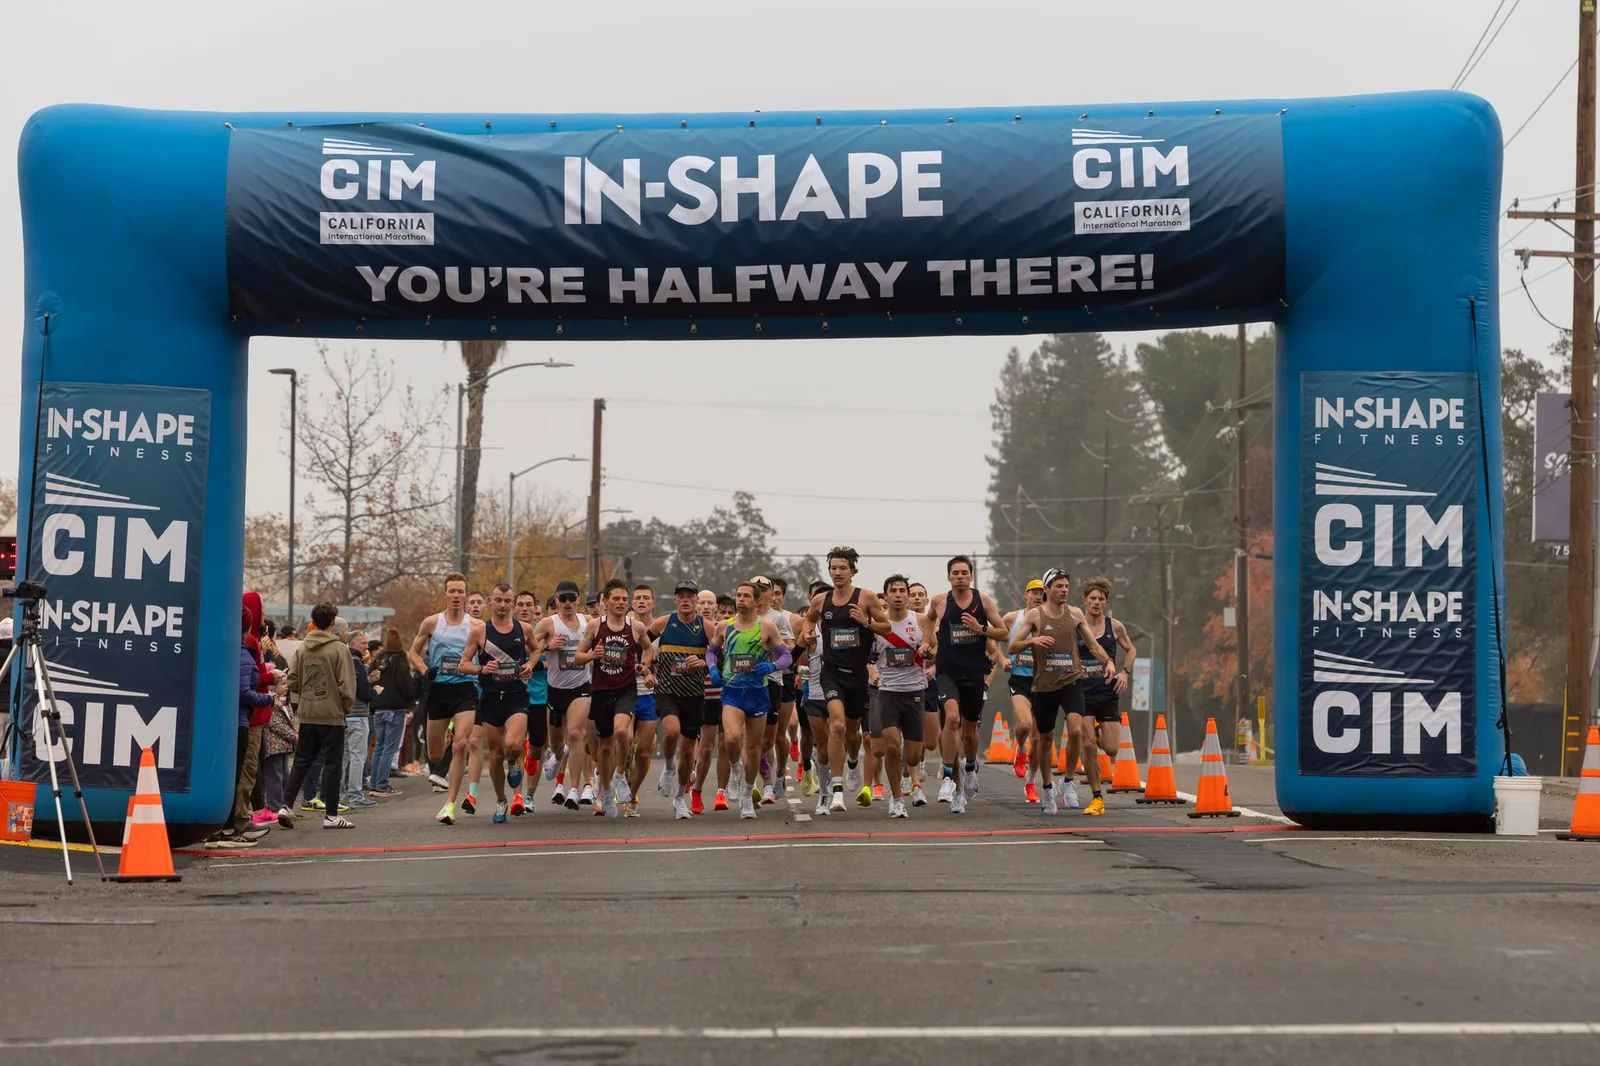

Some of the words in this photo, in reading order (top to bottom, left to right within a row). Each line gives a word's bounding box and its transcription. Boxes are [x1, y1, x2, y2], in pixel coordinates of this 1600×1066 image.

[321, 159, 436, 201] CIM
[1072, 146, 1190, 189] CIM
[564, 150, 943, 225] IN-SHAPE
[328, 217, 426, 230] CALIFORNIA
[1083, 203, 1182, 219] CALIFORNIA
[1083, 221, 1139, 229] International
[1141, 219, 1182, 227] Marathon
[328, 232, 383, 240] International
[608, 261, 908, 304] HALFWAY
[926, 253, 1155, 296] THERE!
[47, 407, 194, 446] IN-SHAPE
[1315, 397, 1465, 429] IN-SHAPE
[46, 443, 193, 462] FITNESS
[1315, 434, 1464, 446] FITNESS
[42, 513, 188, 582] CIM
[1315, 504, 1463, 567] CIM
[37, 598, 183, 638] IN-SHAPE
[1313, 590, 1463, 623] IN-SHAPE
[1313, 626, 1462, 638] FITNESS
[605, 650, 621, 658] 466
[32, 700, 178, 769] CIM
[1313, 691, 1462, 754] CIM
